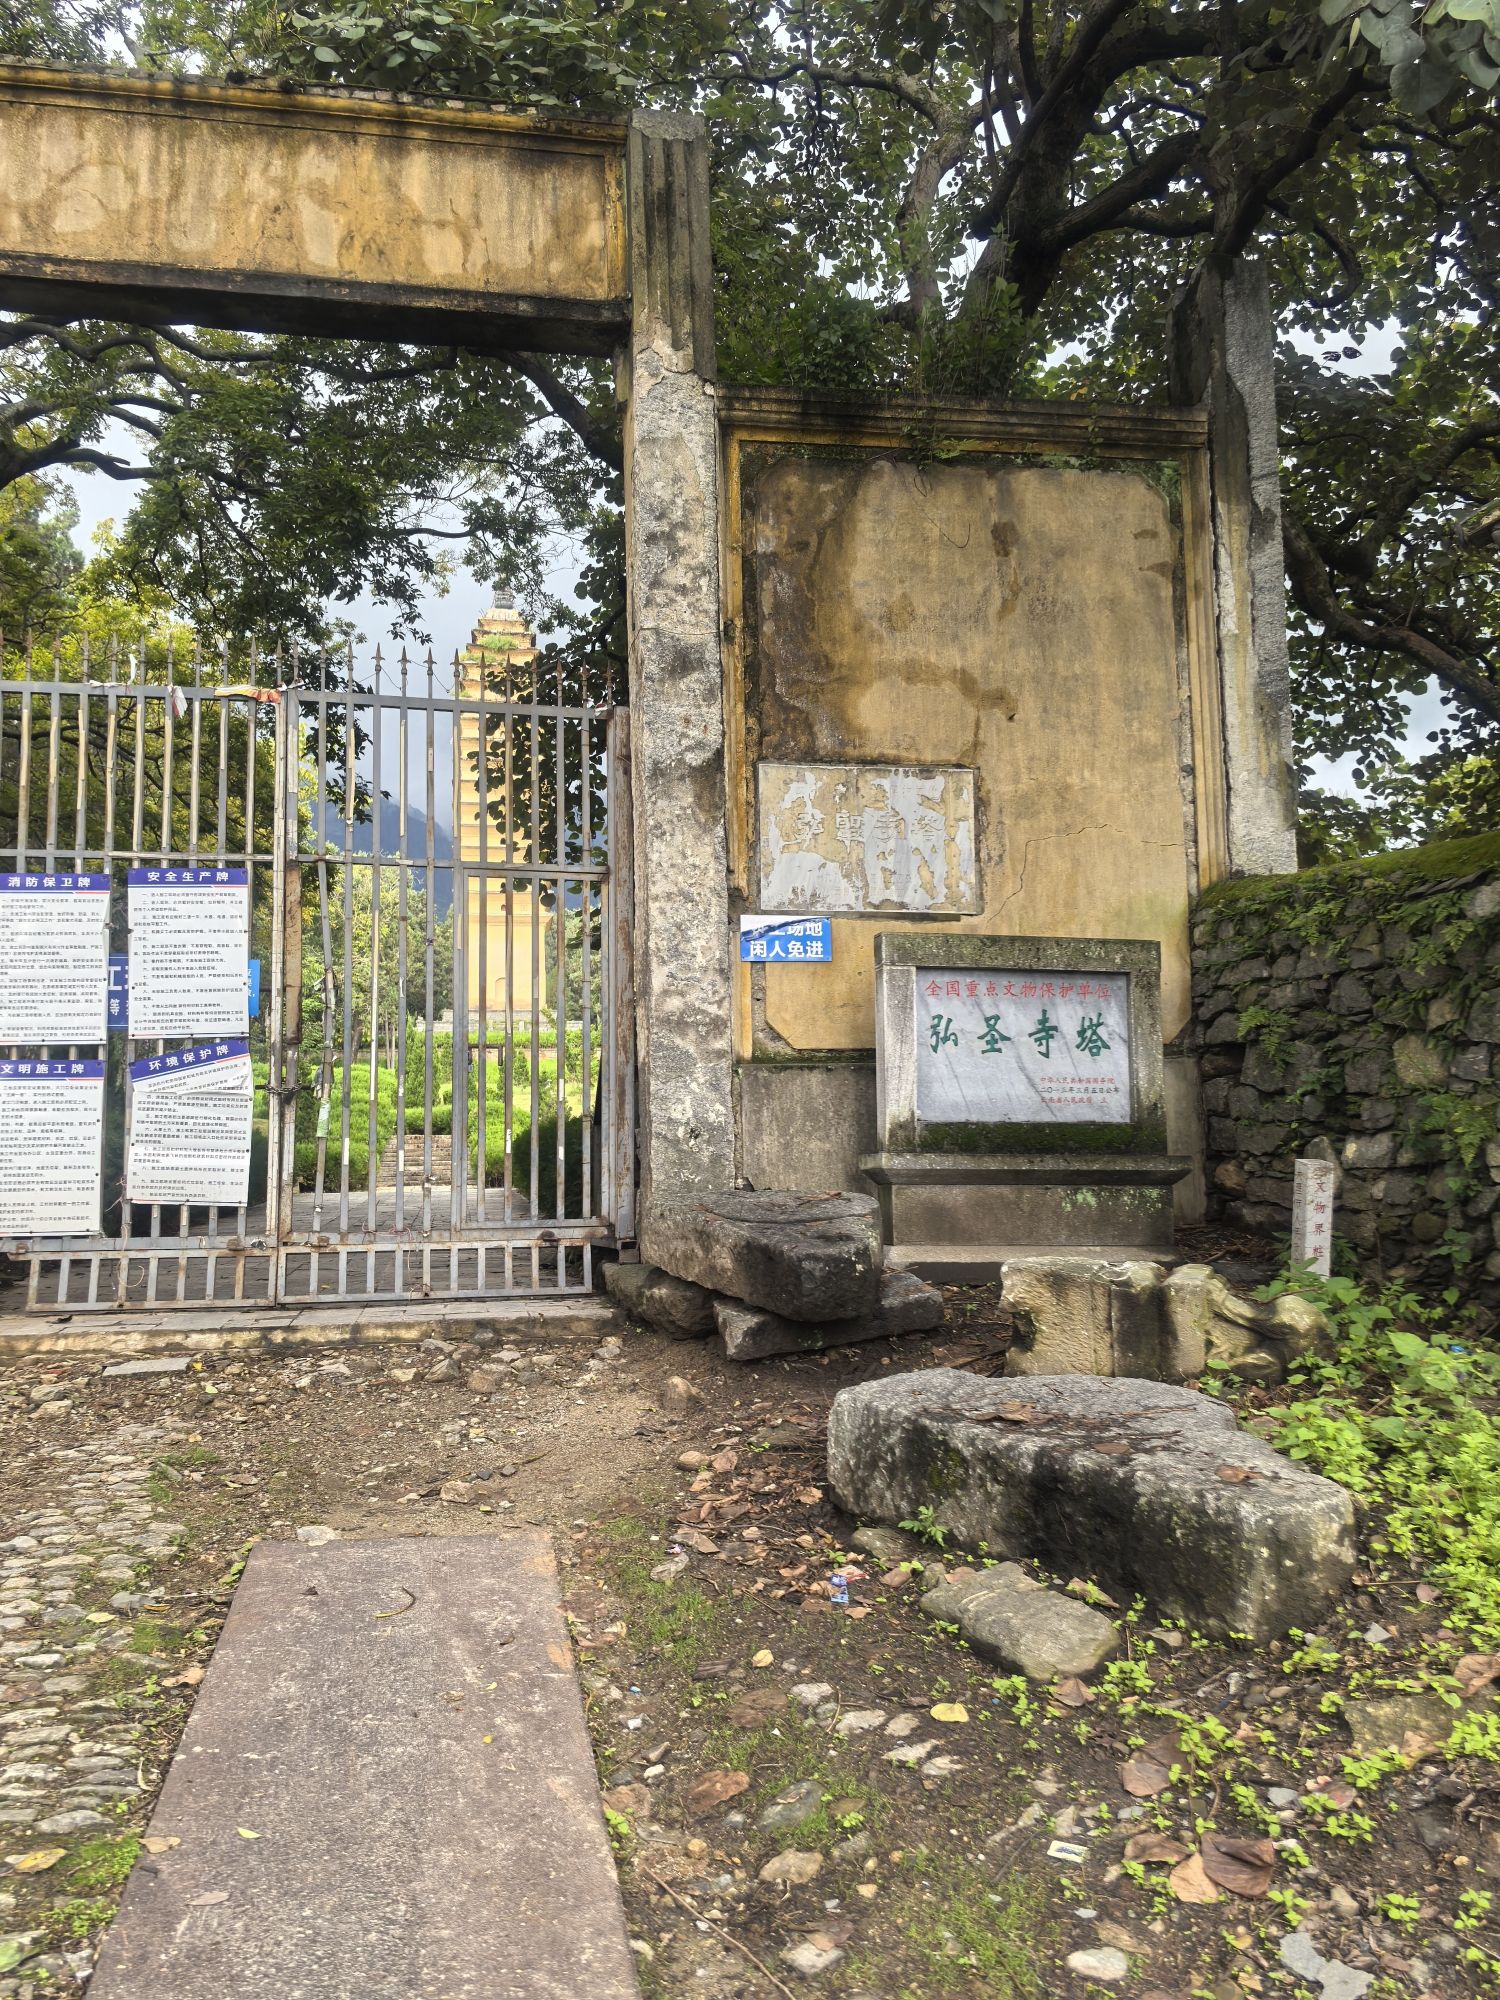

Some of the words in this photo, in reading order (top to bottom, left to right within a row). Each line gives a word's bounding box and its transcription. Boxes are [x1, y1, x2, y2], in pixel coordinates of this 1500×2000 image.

[8, 876, 91, 888] 消防保卫牌
[147, 871, 229, 882] 安全生产牌
[749, 940, 824, 958] 闲人免进
[925, 979, 1113, 1001] 全国重点文物保护单位
[928, 1008, 1111, 1059] 弘圣寺塔
[148, 1044, 229, 1071] 环境保护牌
[1, 1063, 85, 1075] 文明施工牌
[1311, 1180, 1327, 1258] 文物界桩
